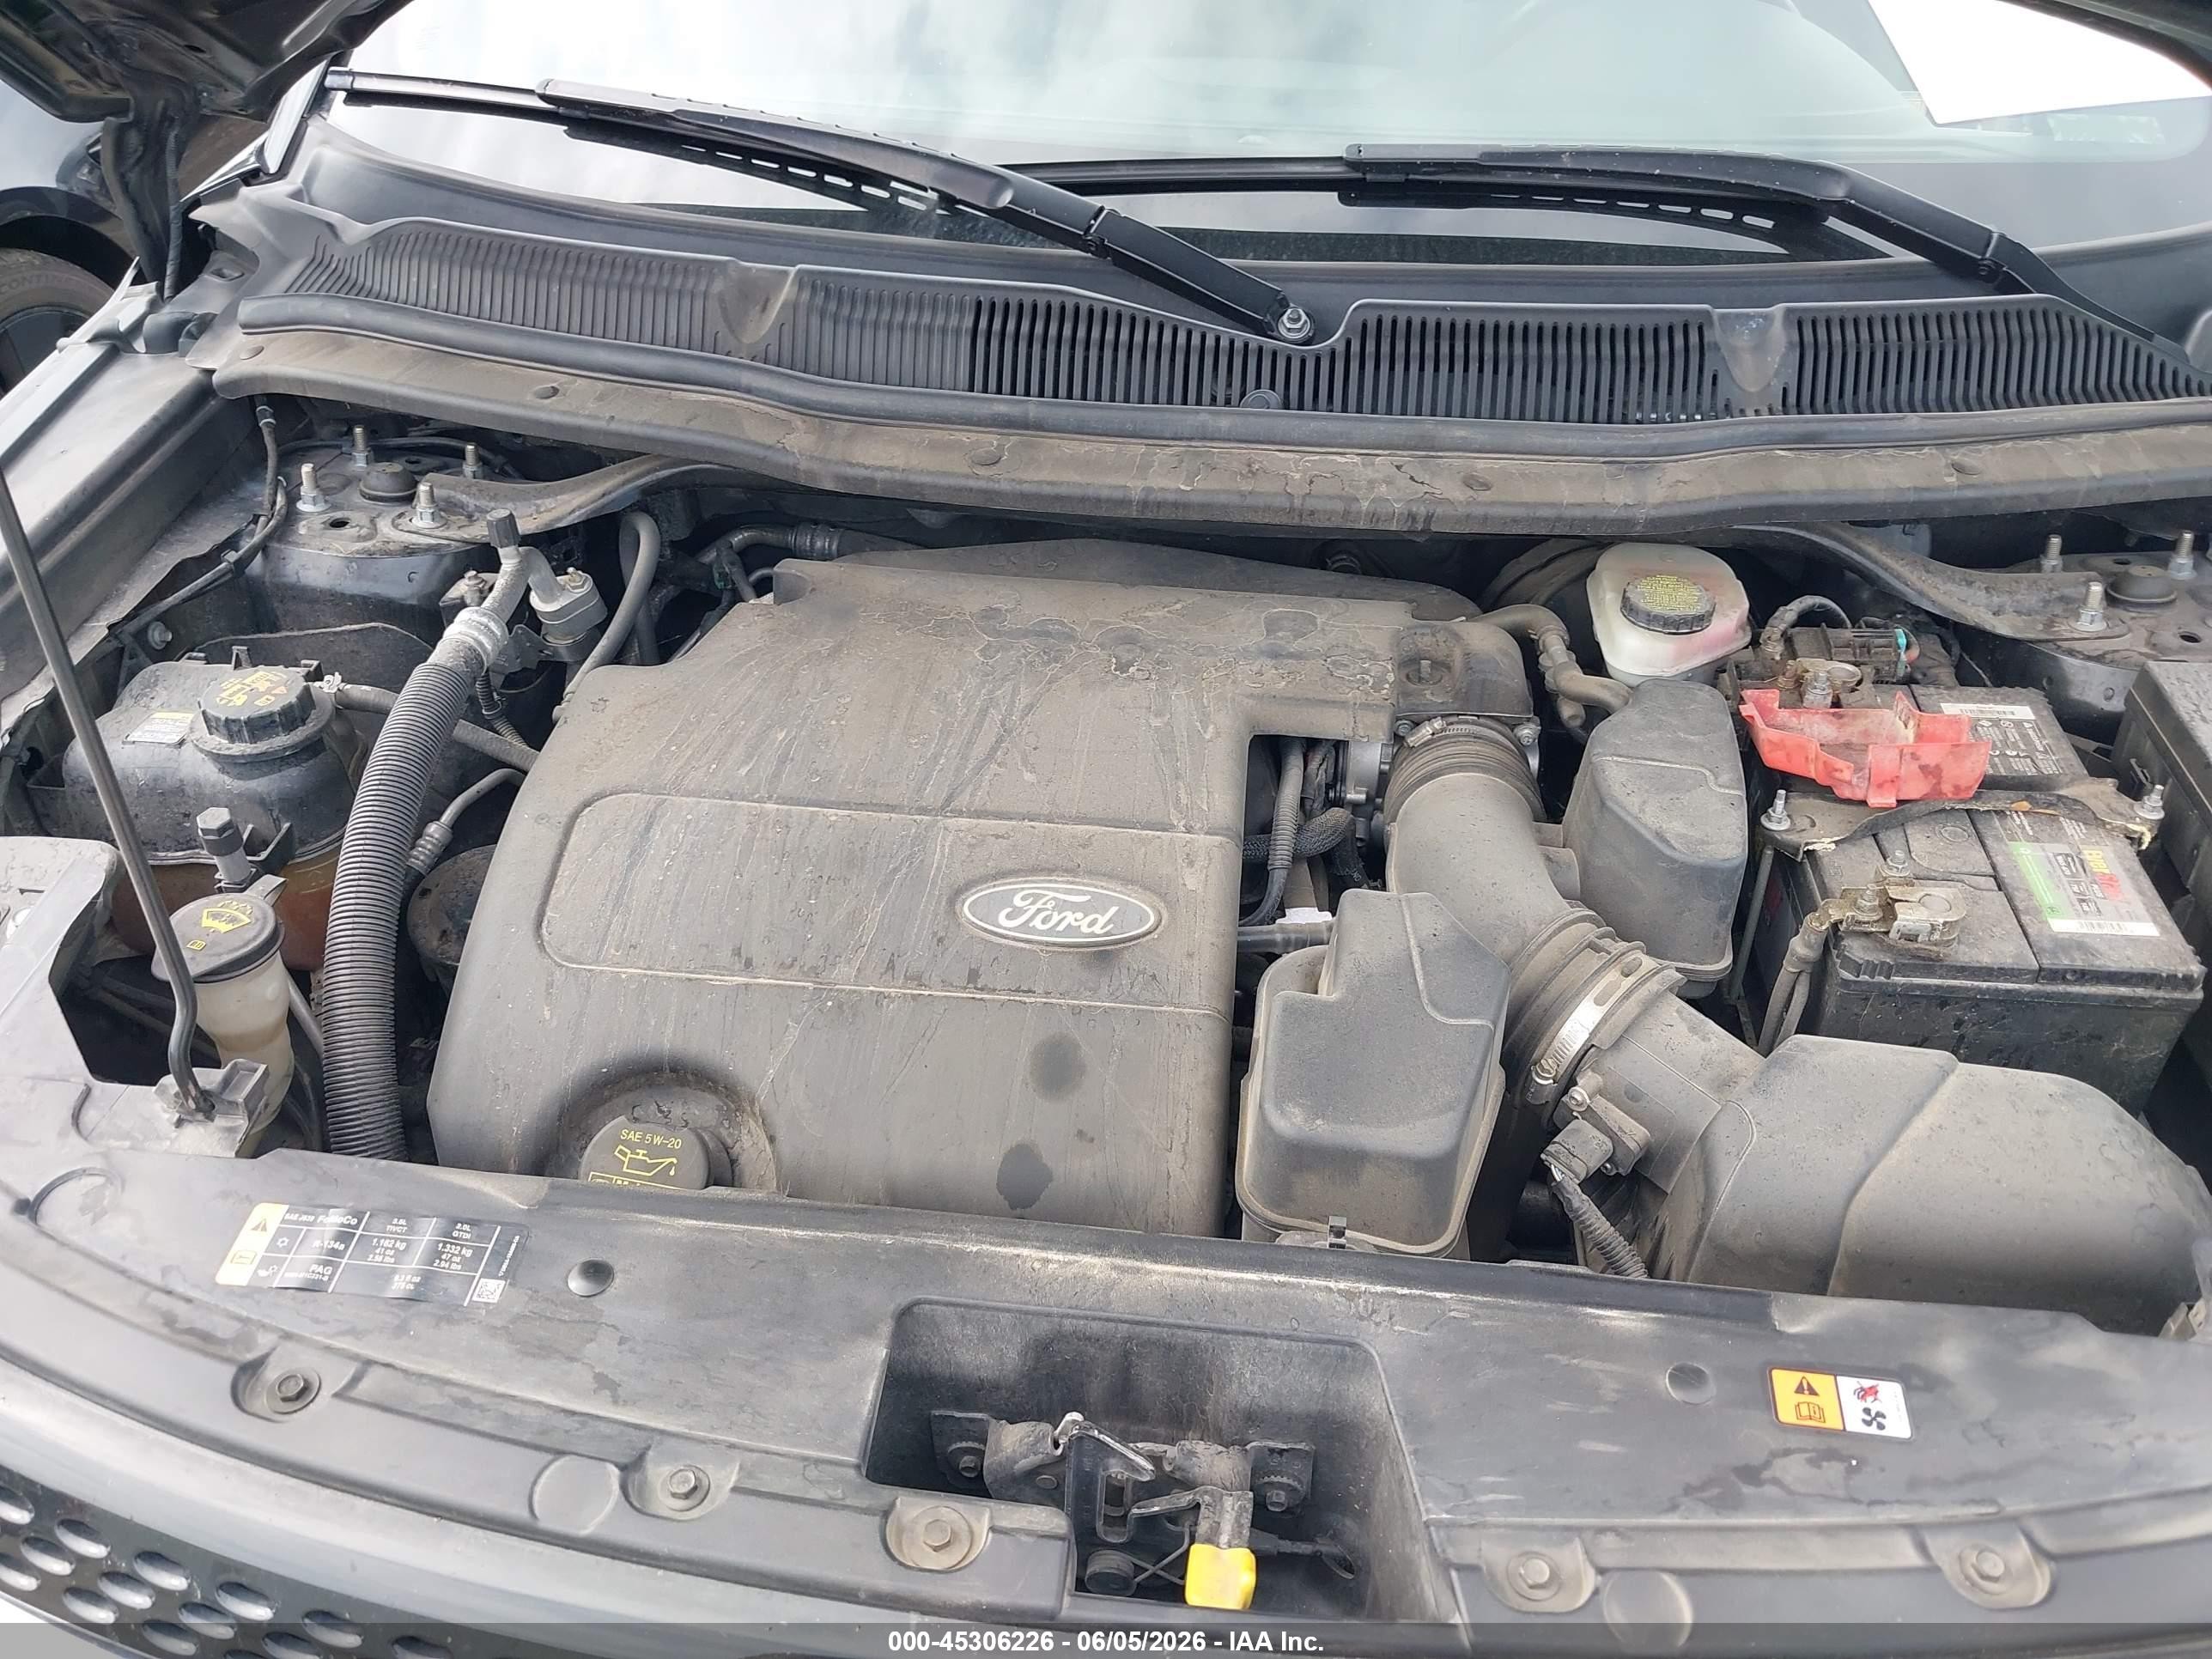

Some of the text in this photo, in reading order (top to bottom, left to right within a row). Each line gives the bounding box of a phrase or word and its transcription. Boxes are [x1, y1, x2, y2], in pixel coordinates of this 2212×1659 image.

[998, 889, 1119, 933] Ford
[620, 1129, 682, 1149] SAE 5W-20
[394, 1240, 407, 1250] kg
[438, 1243, 473, 1257] 1.332 kg
[309, 1264, 333, 1275] PAG
